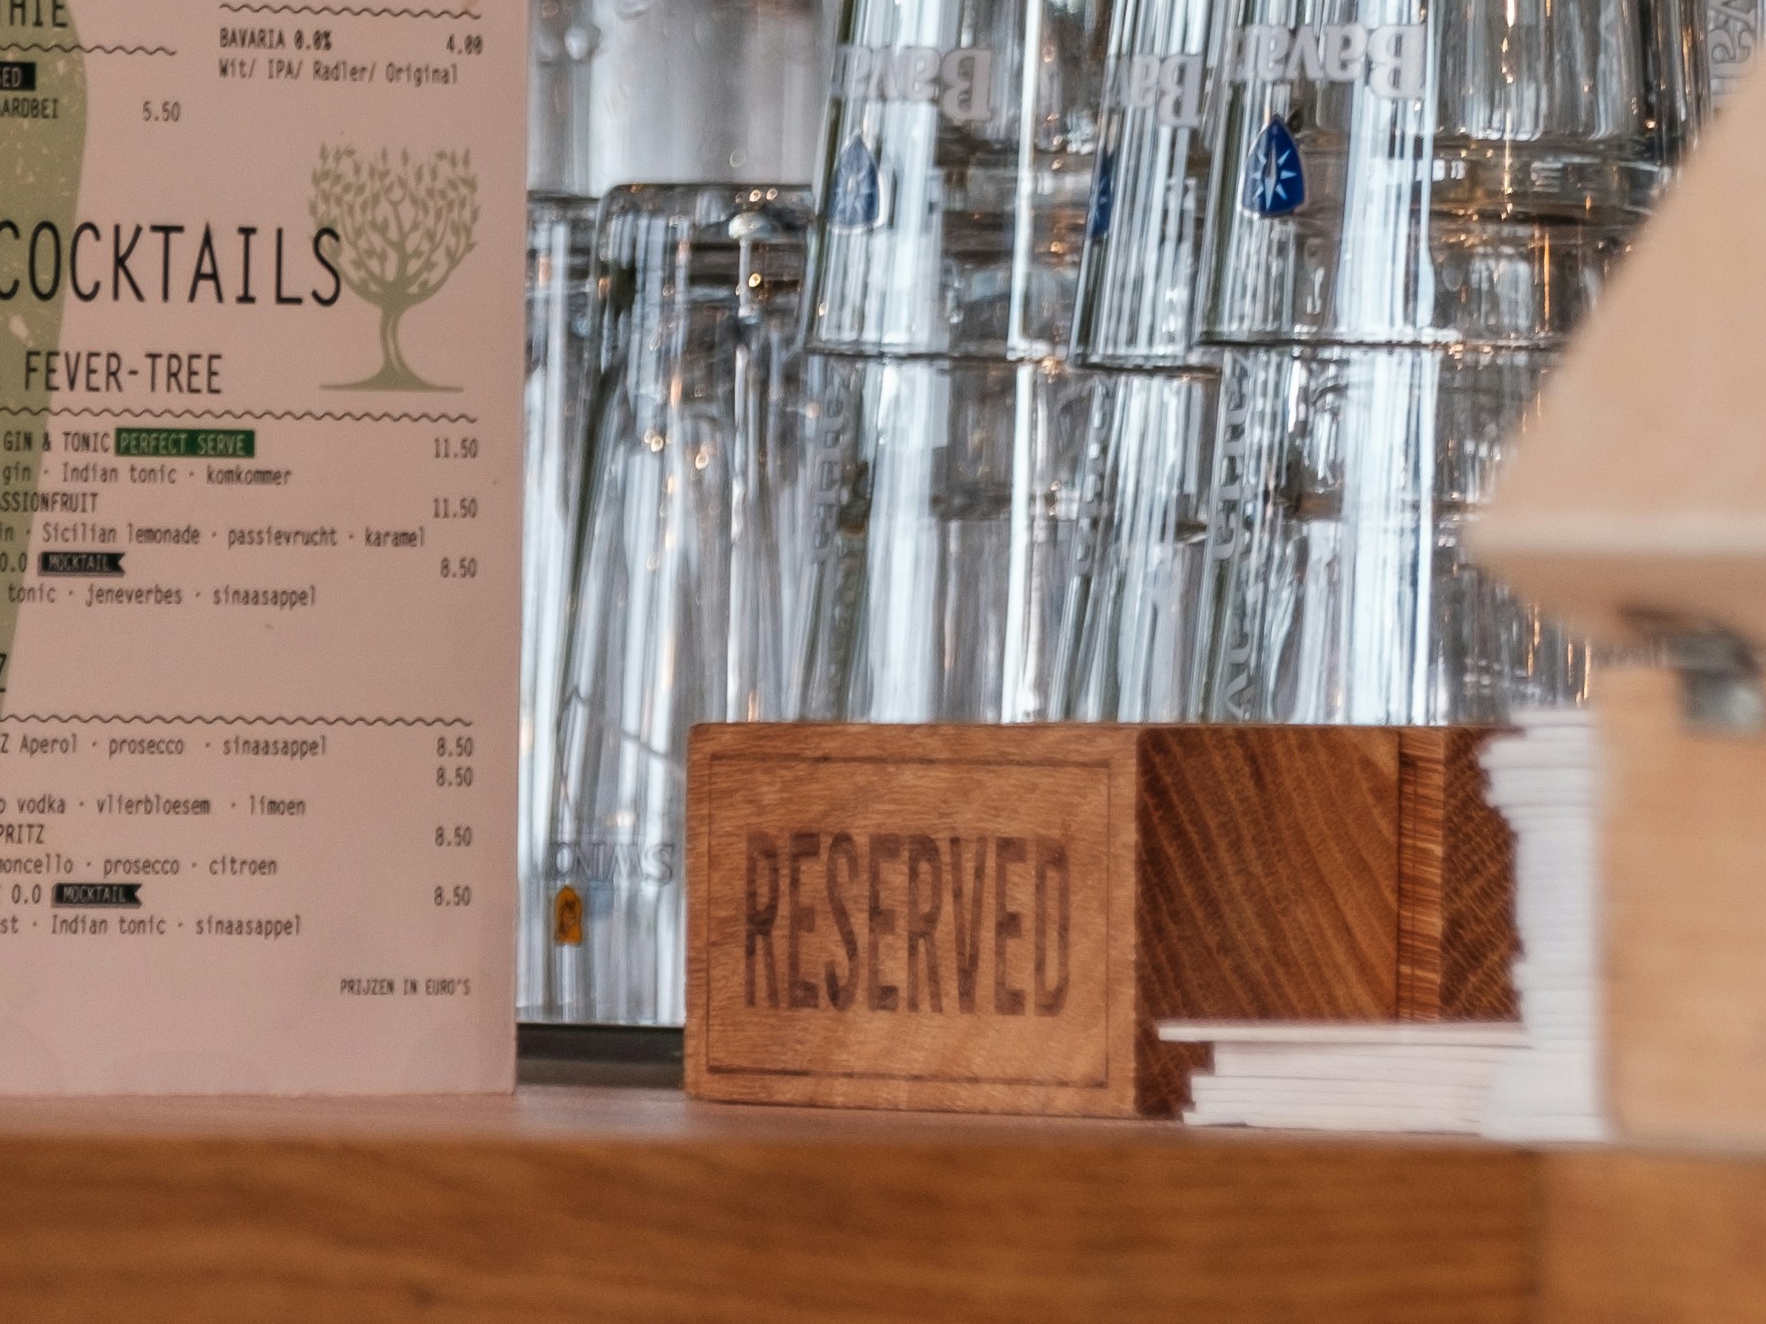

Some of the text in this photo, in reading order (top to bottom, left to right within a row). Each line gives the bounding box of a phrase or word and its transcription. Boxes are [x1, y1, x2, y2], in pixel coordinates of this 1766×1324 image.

[220, 27, 285, 48] BAVARIA
[385, 61, 458, 87] Original
[142, 100, 181, 122] 5.50
[23, 349, 223, 395] FEVER-TREE
[3, 430, 33, 451] GIN
[62, 431, 109, 452] TONIC
[118, 431, 187, 454] PERFECT
[196, 432, 247, 453] SERVE
[434, 437, 479, 458] 11.50
[62, 461, 119, 482] Indian
[129, 464, 177, 484] tonic
[206, 465, 292, 485] komkommer
[42, 521, 117, 543] Sicilian
[127, 521, 201, 544] lemonade
[228, 526, 337, 547] passievrucht
[365, 526, 424, 547] karamel
[7, 582, 57, 603] tonic
[85, 583, 183, 607] jeneverbes
[213, 584, 316, 608] sinaasappel
[19, 733, 77, 756] Aperol
[107, 736, 185, 759] prosecco
[223, 735, 326, 758] sinaasappel
[436, 736, 474, 757] 8.50
[744, 829, 1072, 1017] RESERVED
[340, 978, 471, 996] PRIJZEN EURO'S
